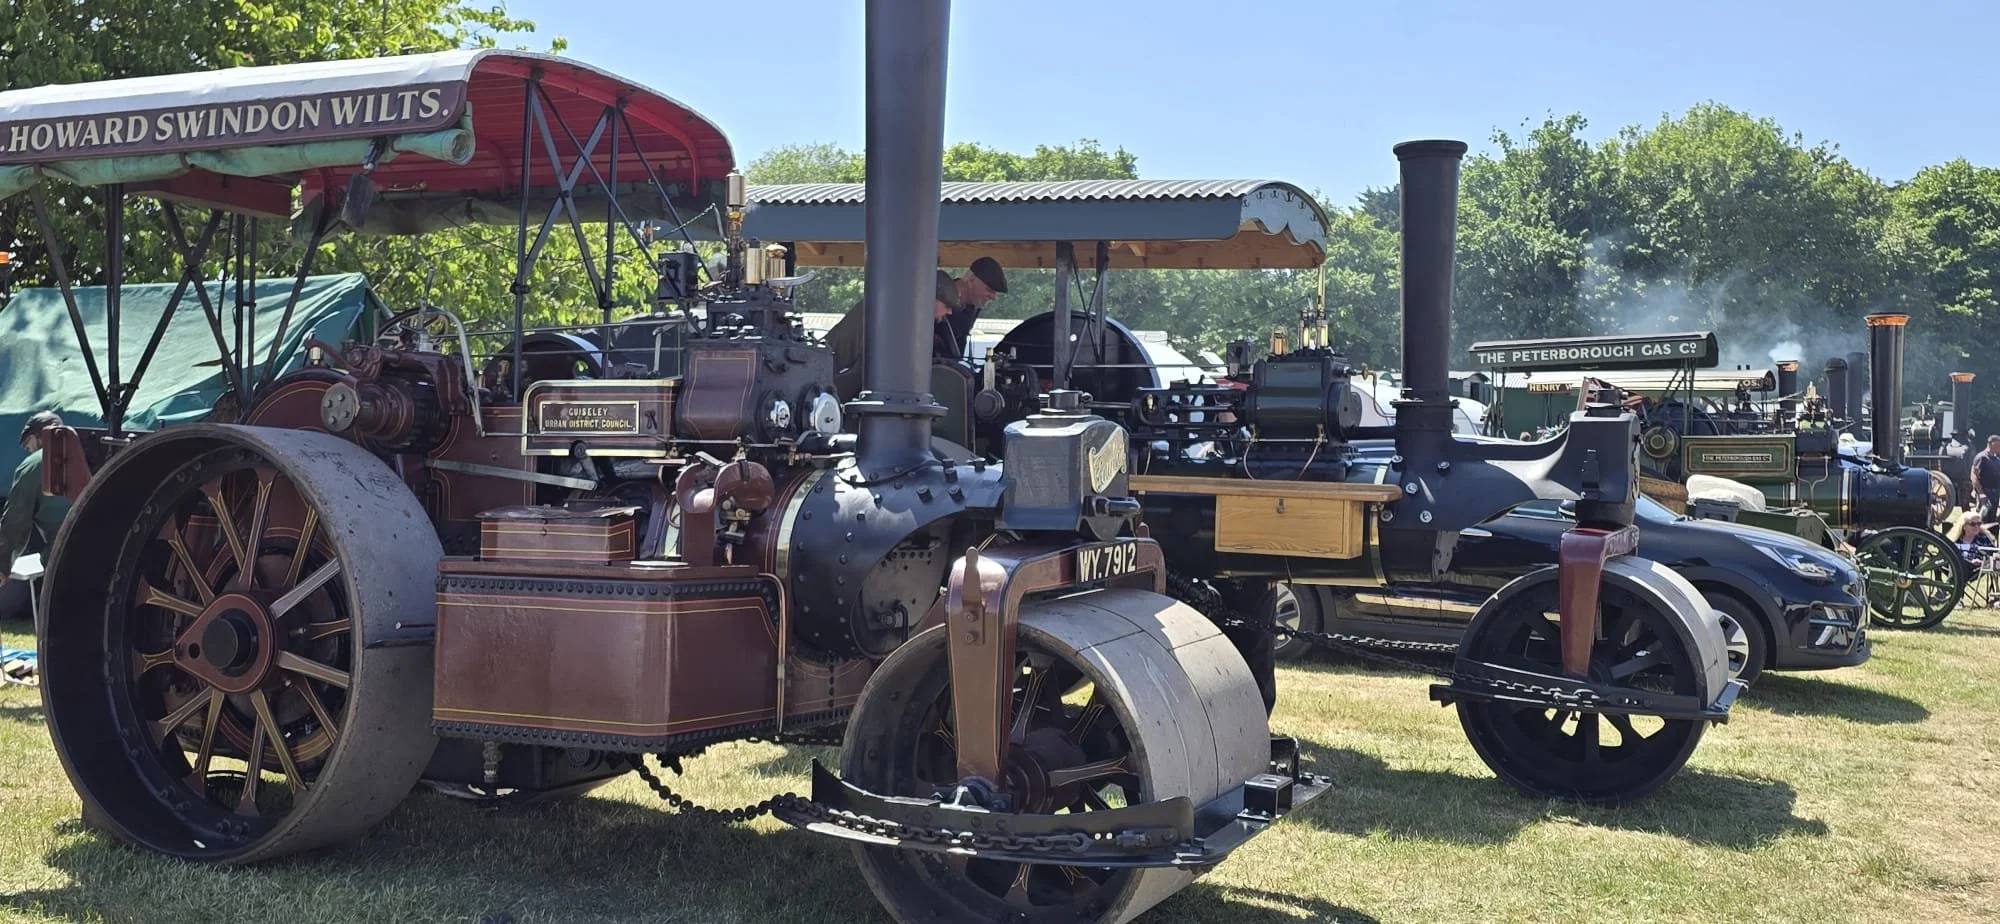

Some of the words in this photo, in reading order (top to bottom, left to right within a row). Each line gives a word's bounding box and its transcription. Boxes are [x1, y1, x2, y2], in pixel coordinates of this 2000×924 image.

[155, 98, 320, 141] SWINDON
[331, 88, 449, 126] WILTS.
[1477, 352, 1506, 364] THE
[1512, 345, 1634, 362] PETERBOROUGH
[1641, 343, 1671, 356] GAS
[1529, 383, 1561, 392] HENRY
[568, 408, 608, 416] GUISELEY
[545, 420, 567, 428] URBAN
[569, 420, 599, 428] DISTRICT
